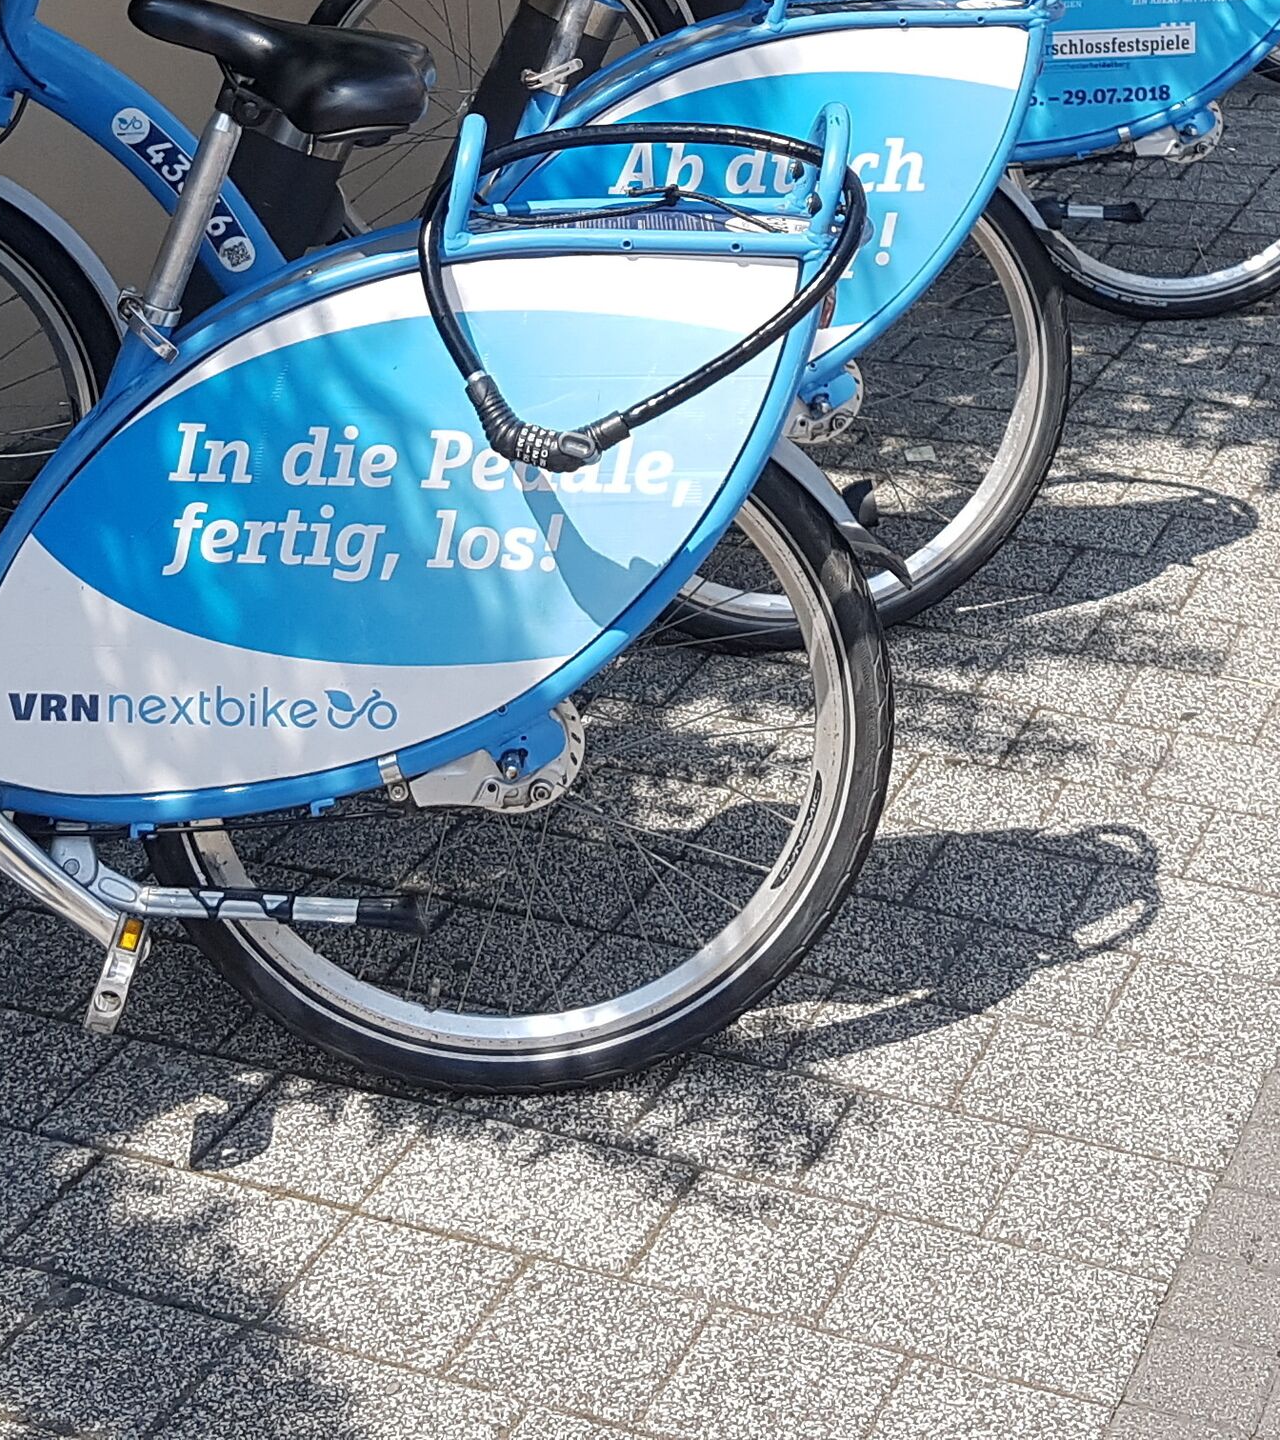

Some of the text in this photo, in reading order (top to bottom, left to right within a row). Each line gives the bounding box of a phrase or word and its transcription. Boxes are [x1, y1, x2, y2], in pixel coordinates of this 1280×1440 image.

[145, 142, 234, 237] 436
[608, 137, 926, 196] Ab duch
[168, 422, 253, 487] In
[282, 425, 398, 488] die
[162, 504, 565, 582] fertig, los!
[8, 686, 318, 729] VRN nextbike
